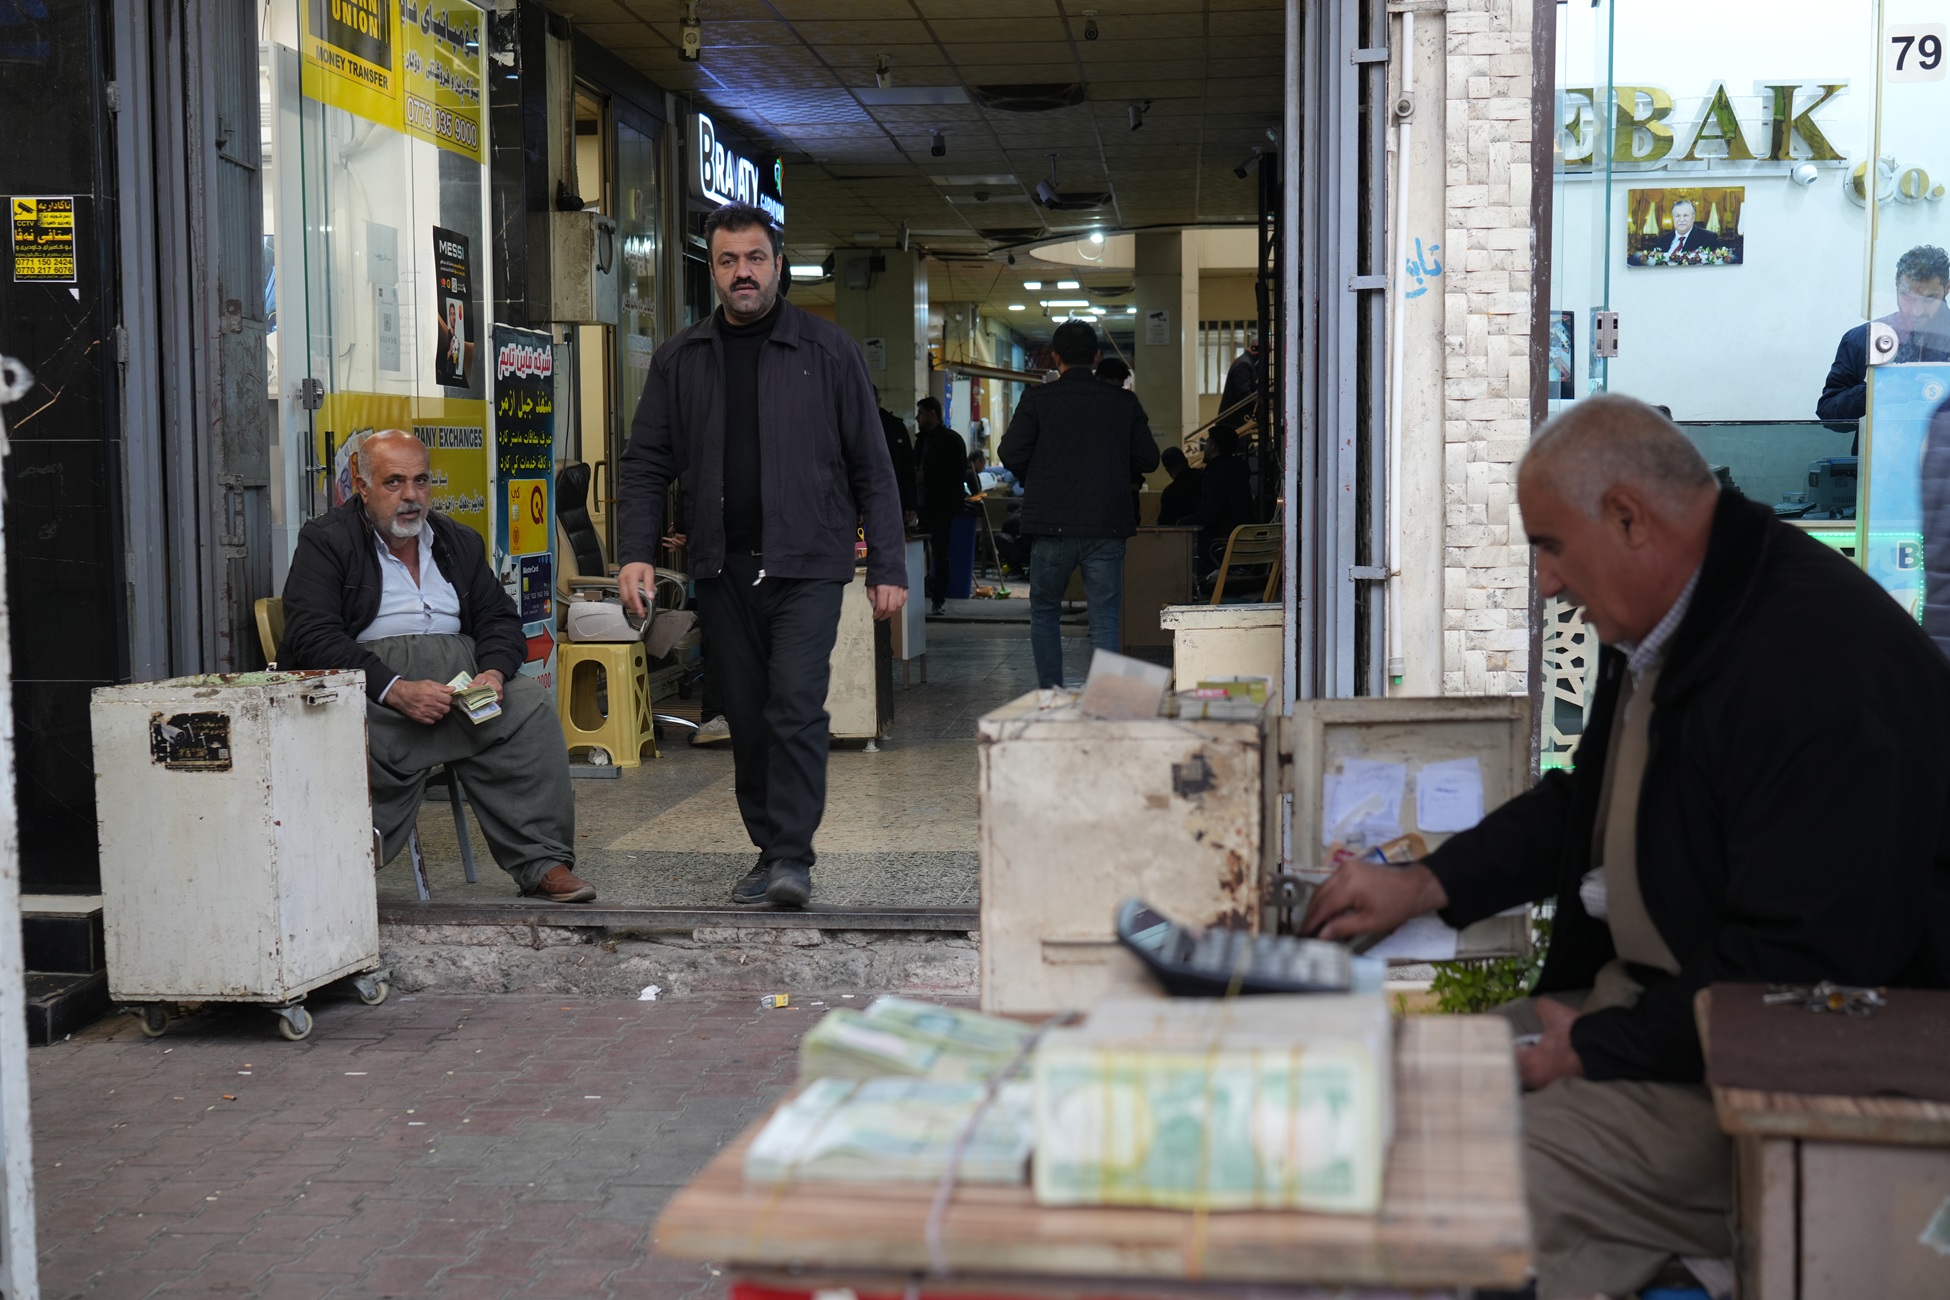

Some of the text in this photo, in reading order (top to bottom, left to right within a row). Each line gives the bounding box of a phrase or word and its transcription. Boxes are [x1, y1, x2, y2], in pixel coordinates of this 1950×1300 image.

[331, 1, 379, 40] UNION
[316, 44, 389, 91] MONEY TRANSFER
[1891, 34, 1943, 71] 79
[407, 96, 478, 148] 0773 035 9000
[439, 240, 465, 260] MESSI
[439, 427, 483, 449] EXCHANGES
